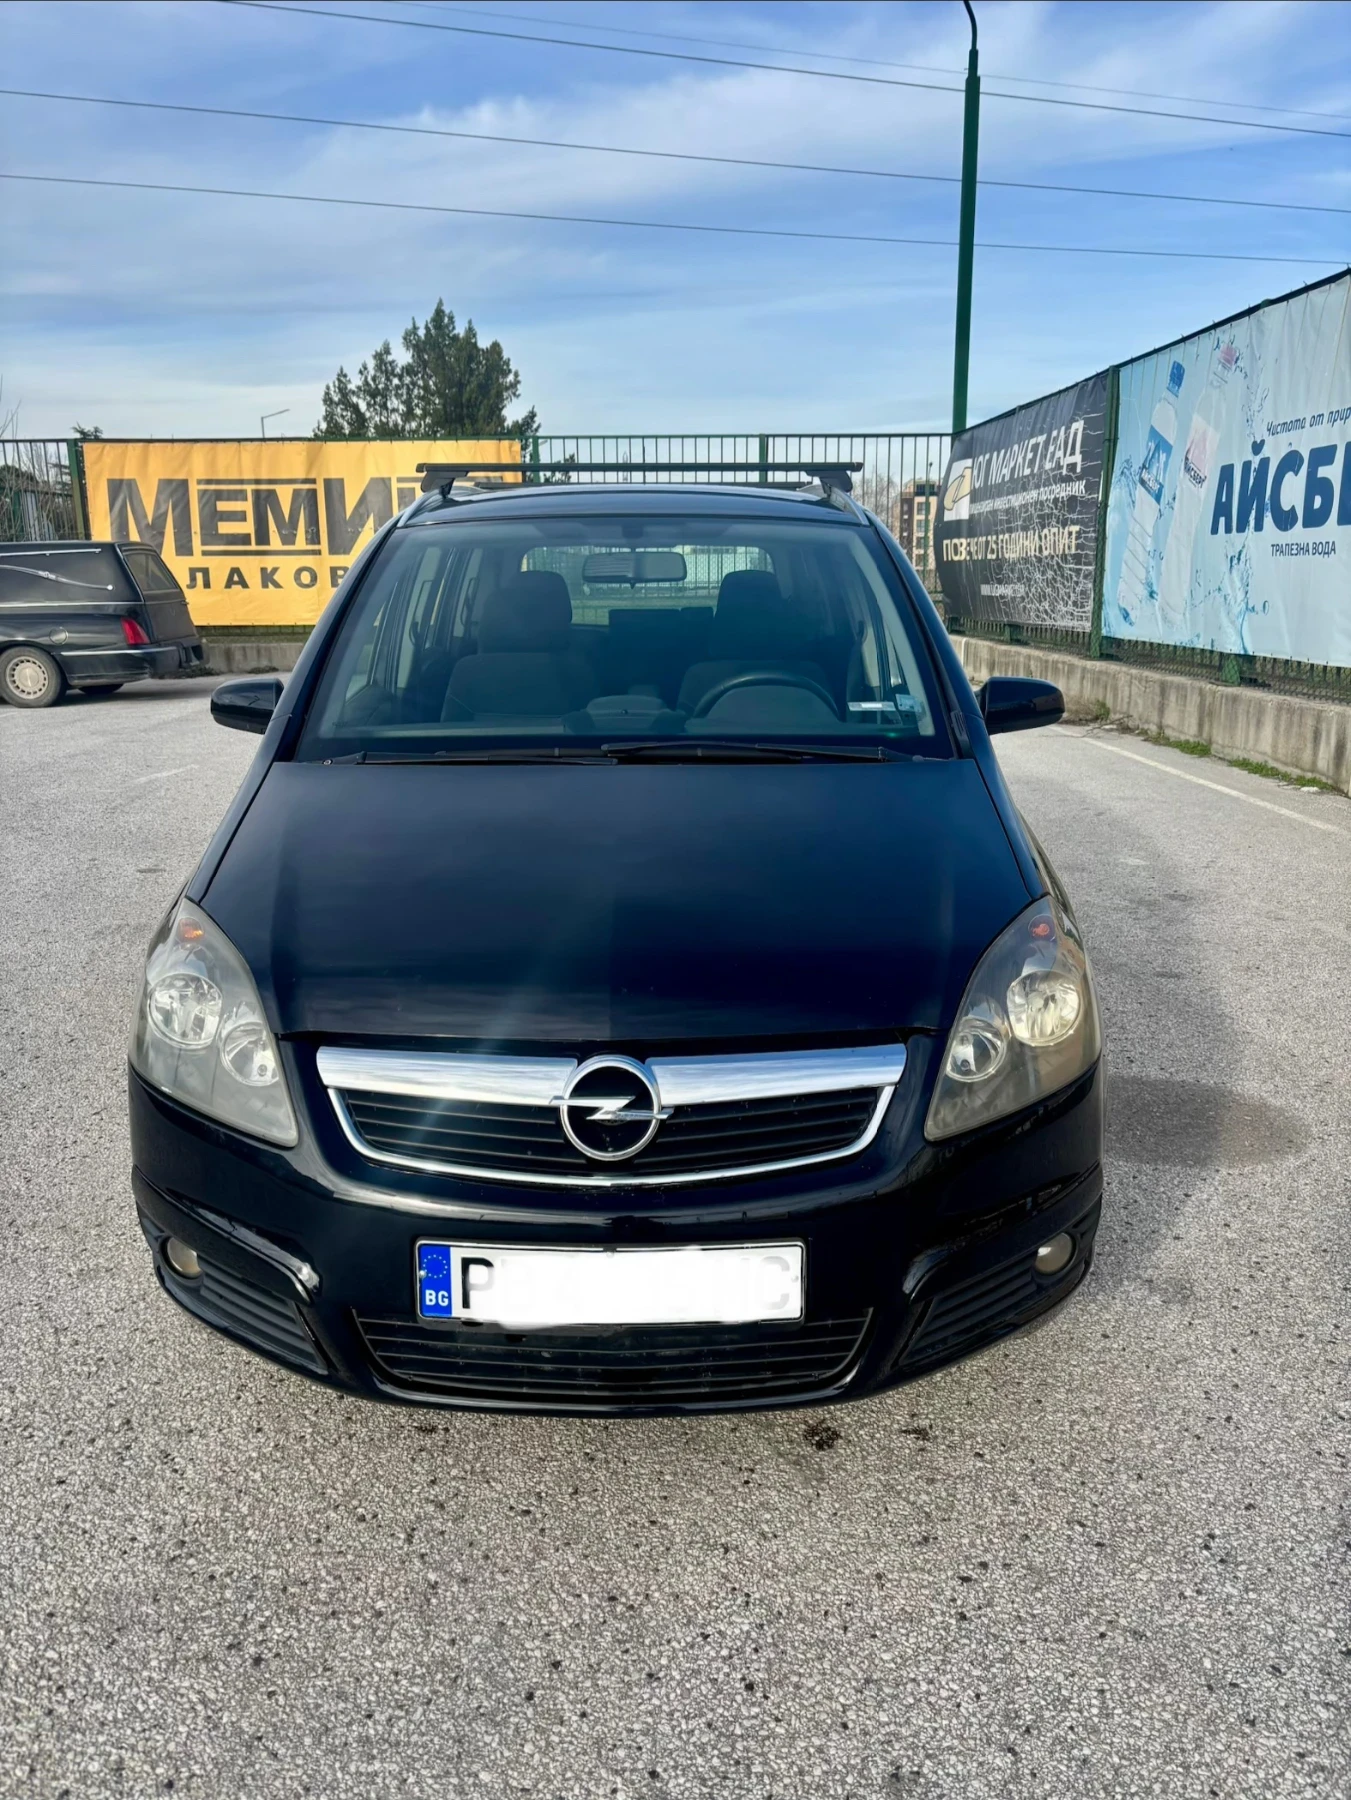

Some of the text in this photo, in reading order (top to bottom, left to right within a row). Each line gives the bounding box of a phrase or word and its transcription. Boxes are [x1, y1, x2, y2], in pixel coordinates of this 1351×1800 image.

[1266, 416, 1307, 437] Чистота
[1309, 412, 1325, 428] от
[988, 433, 1048, 486] МАРКЕТ
[1045, 419, 1085, 476] ЕАД
[106, 477, 417, 557] МЕМИ
[986, 535, 997, 560] 25
[1042, 525, 1080, 556] ОПИТ
[1271, 540, 1337, 558] ТРАПЕЗНА ВОДА
[424, 1289, 449, 1307] BG
